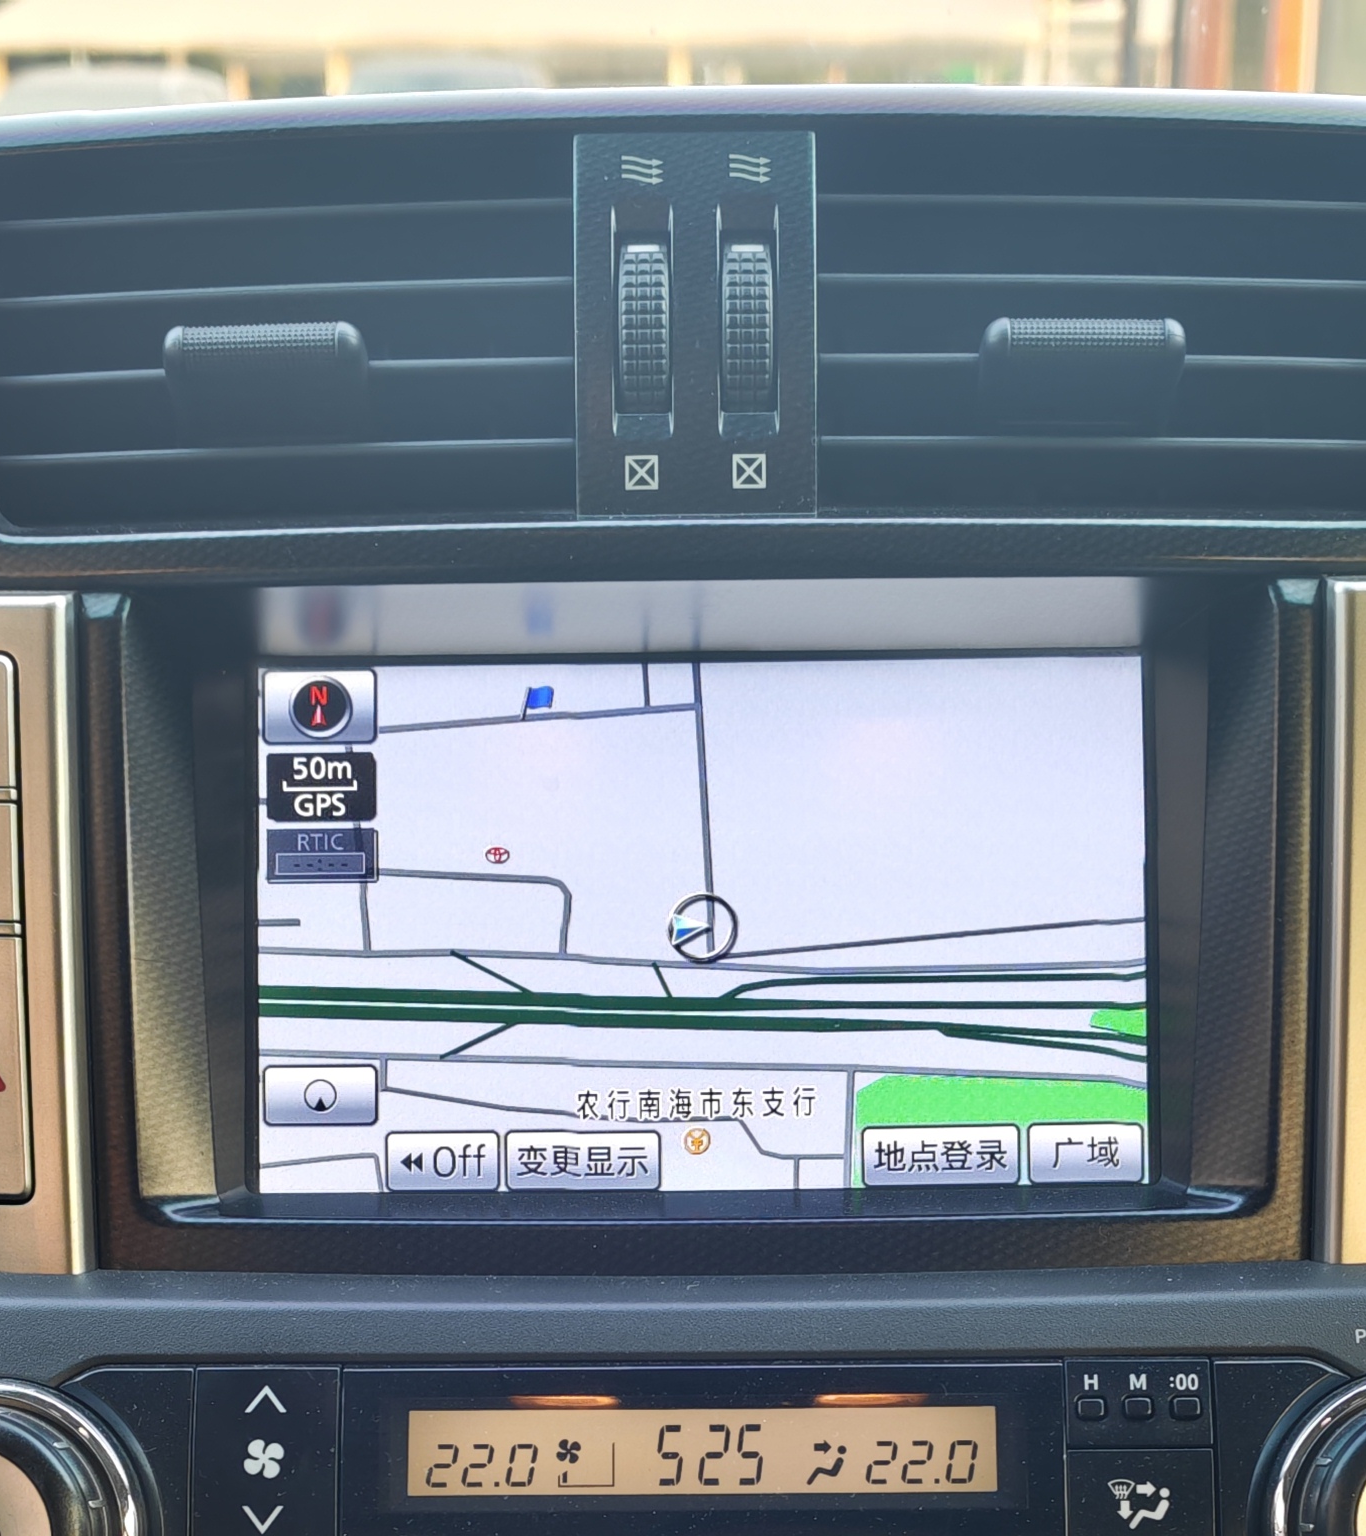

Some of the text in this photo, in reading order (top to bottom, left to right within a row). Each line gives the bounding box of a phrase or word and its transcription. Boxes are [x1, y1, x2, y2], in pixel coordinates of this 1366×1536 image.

[310, 685, 328, 705] N
[293, 756, 353, 781] 50m
[294, 793, 347, 818] GPS
[297, 833, 345, 852] RTIC
[576, 1086, 818, 1121] 农行南海市东支行
[433, 1143, 486, 1178] Off
[515, 1144, 650, 1178] 变更显示
[873, 1139, 1009, 1173] 地点登录
[1051, 1135, 1121, 1170] 广域
[1083, 1374, 1099, 1391] H
[1128, 1374, 1148, 1391] M
[1168, 1373, 1200, 1391] :00
[425, 1443, 538, 1488] 22.0
[864, 1439, 979, 1486] 22.0
